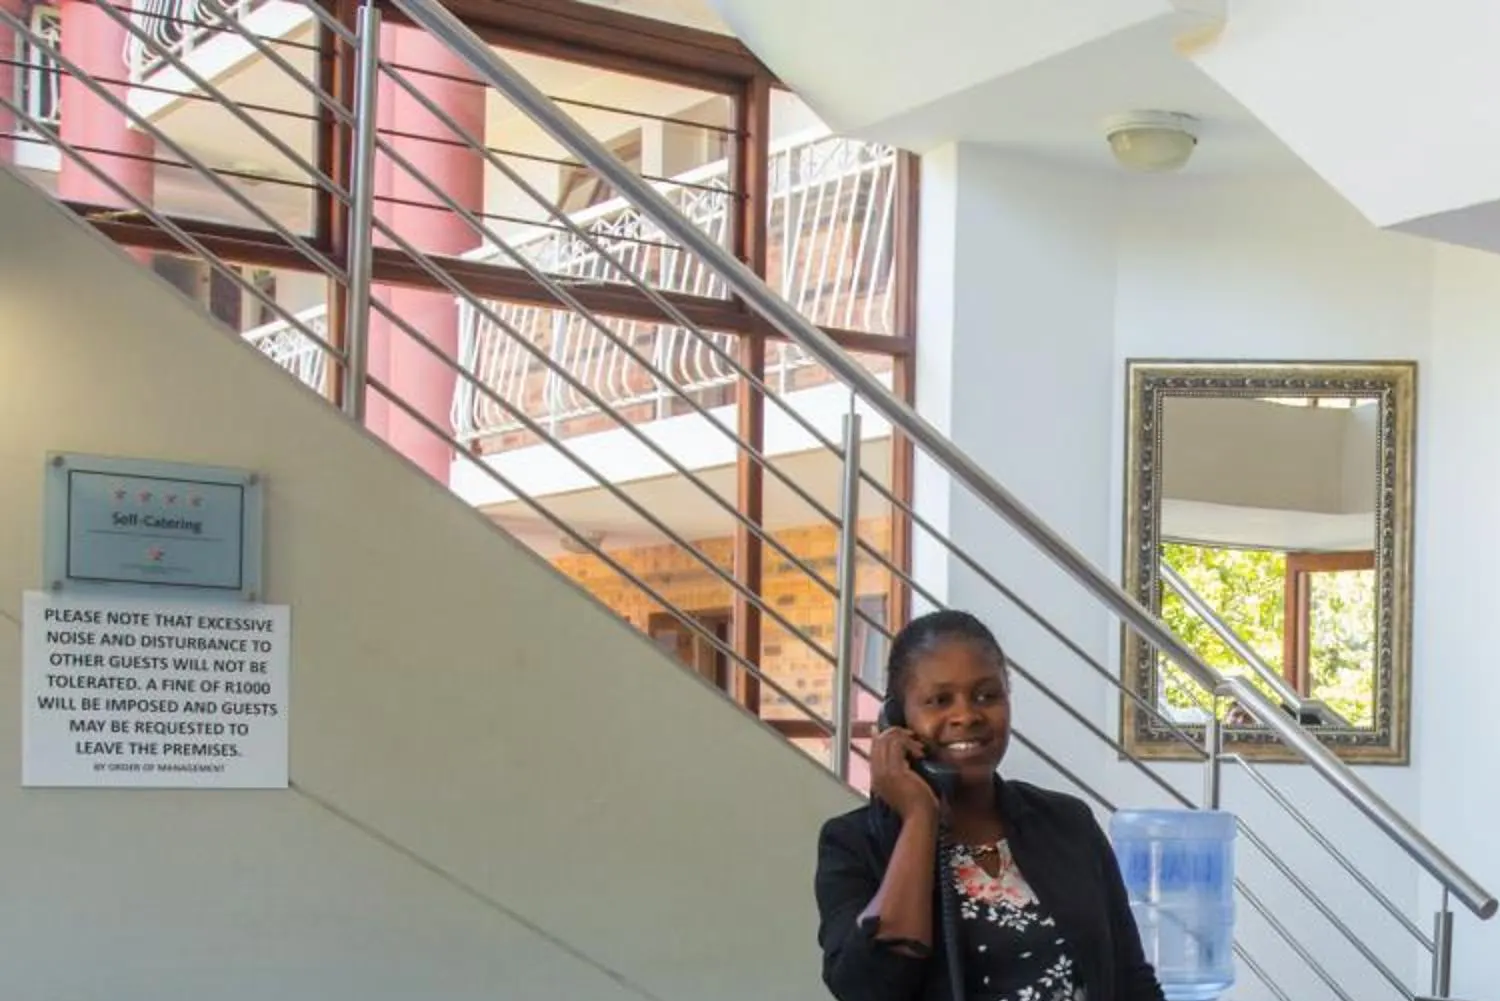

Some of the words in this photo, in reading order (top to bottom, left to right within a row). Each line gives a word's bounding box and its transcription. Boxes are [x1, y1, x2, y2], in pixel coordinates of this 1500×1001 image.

[45, 609, 101, 624] PLEASE
[106, 611, 149, 626] NOTE
[155, 614, 192, 628] THAT
[198, 616, 273, 632] EXCESSIVE
[47, 631, 95, 645] NOISE
[100, 633, 136, 647] AND
[141, 635, 247, 652] DISTURBANCE
[252, 640, 272, 653] TO
[49, 653, 104, 667] OTHER
[109, 655, 168, 670] GUESTS
[173, 658, 208, 671] WILL
[214, 659, 245, 673] NOT
[250, 661, 267, 674] BE
[47, 675, 141, 691] TOLERATED.
[146, 678, 159, 691] A
[162, 679, 195, 693] FINE
[200, 680, 220, 693] OF
[225, 681, 271, 695] R1000
[37, 696, 76, 711] WILL
[81, 697, 101, 711] BE
[105, 698, 179, 714] IMPOSED
[183, 701, 217, 714] AND
[221, 701, 278, 716] GUESTS
[69, 719, 106, 733] MAY
[111, 720, 129, 733] BE
[134, 720, 225, 736] REQUESTED
[229, 722, 249, 736] TO
[75, 741, 125, 755] LEAVE
[128, 742, 158, 756] THE
[163, 743, 242, 757] PREMISES.
[93, 763, 105, 771] BY
[142, 763, 155, 772] OF
[157, 763, 225, 773] MANAGEMENT
